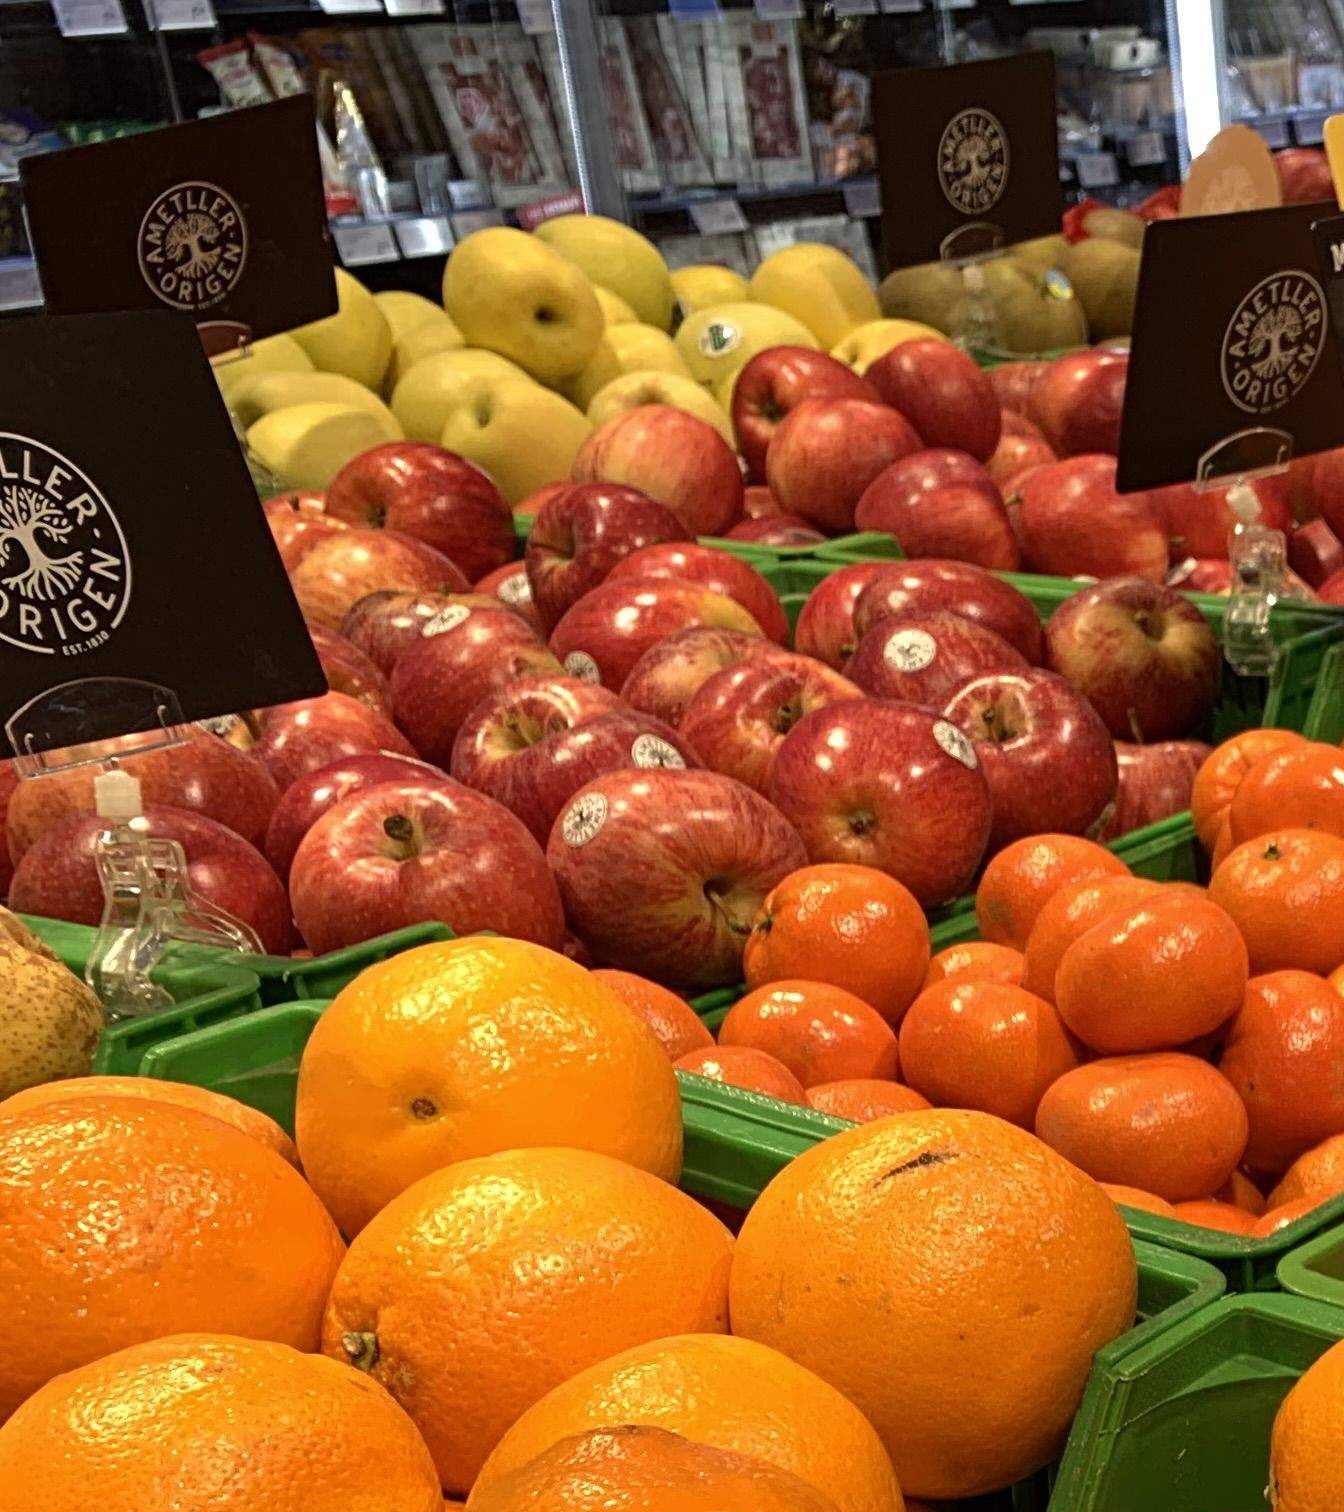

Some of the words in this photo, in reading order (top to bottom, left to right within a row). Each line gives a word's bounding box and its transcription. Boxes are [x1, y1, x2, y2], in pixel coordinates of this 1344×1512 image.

[145, 190, 236, 263] AMETLLER
[160, 242, 242, 302] ORIGEN
[1229, 279, 1322, 358] AMETLLER
[1233, 343, 1317, 404] ORIGEN
[0, 450, 98, 527] LLER
